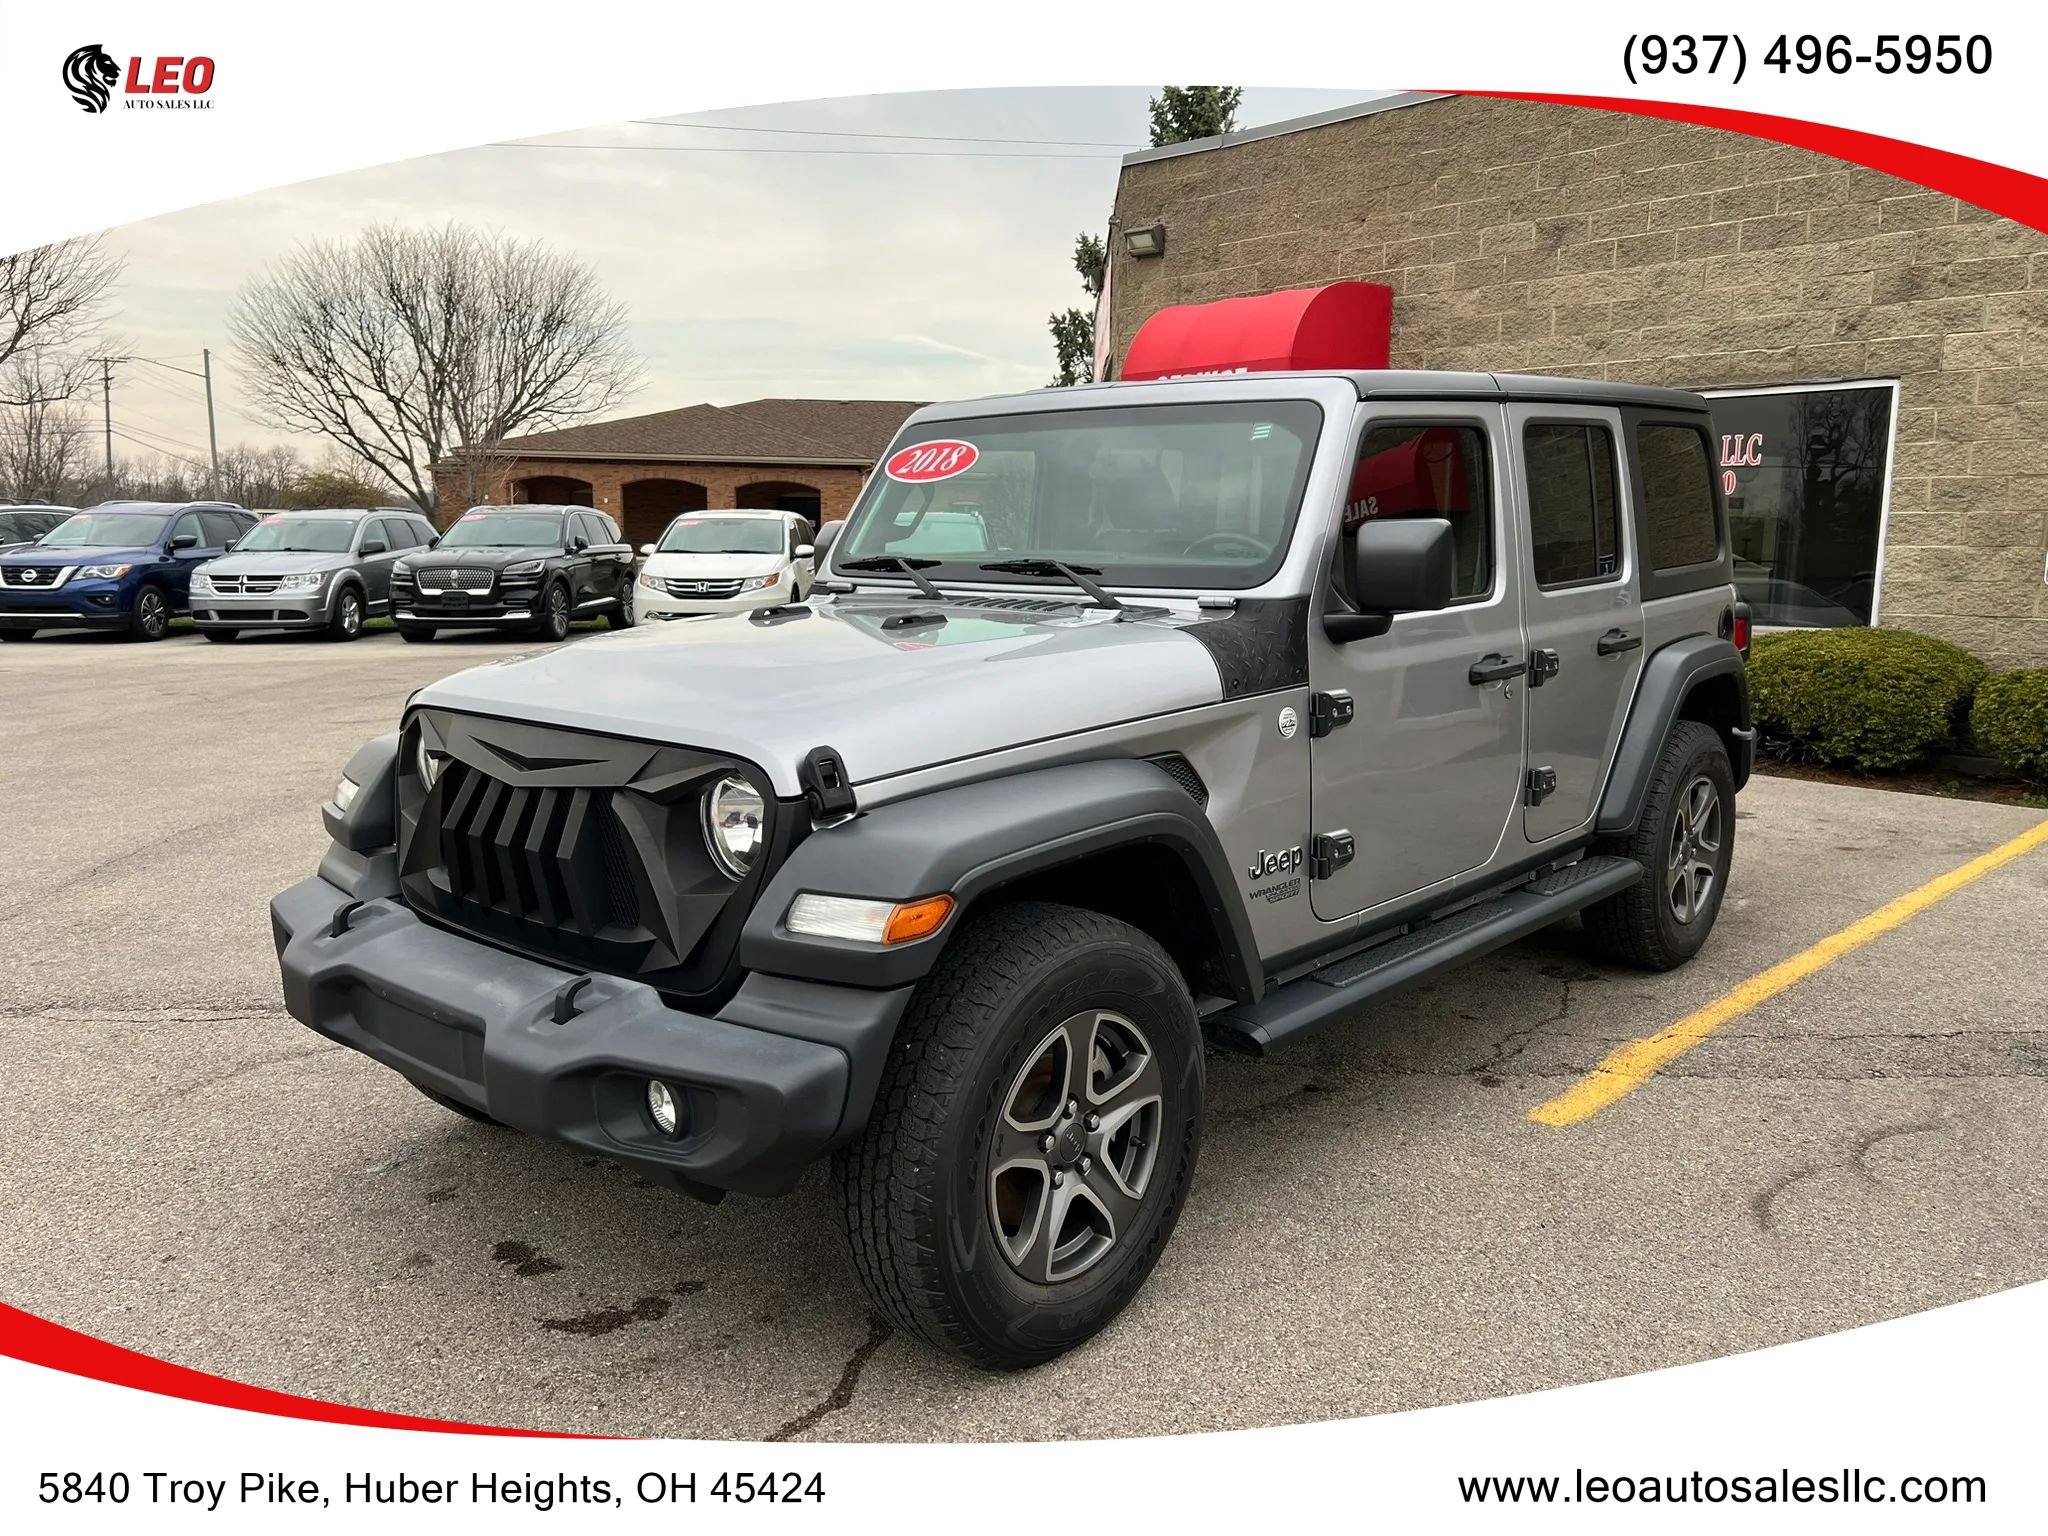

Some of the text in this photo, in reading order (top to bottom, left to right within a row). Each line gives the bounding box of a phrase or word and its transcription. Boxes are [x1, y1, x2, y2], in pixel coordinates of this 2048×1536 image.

[895, 446, 967, 474] 2018
[1720, 433, 1762, 467] LLC
[1248, 846, 1302, 880] Jeep
[1249, 878, 1301, 900] WRANGLER
